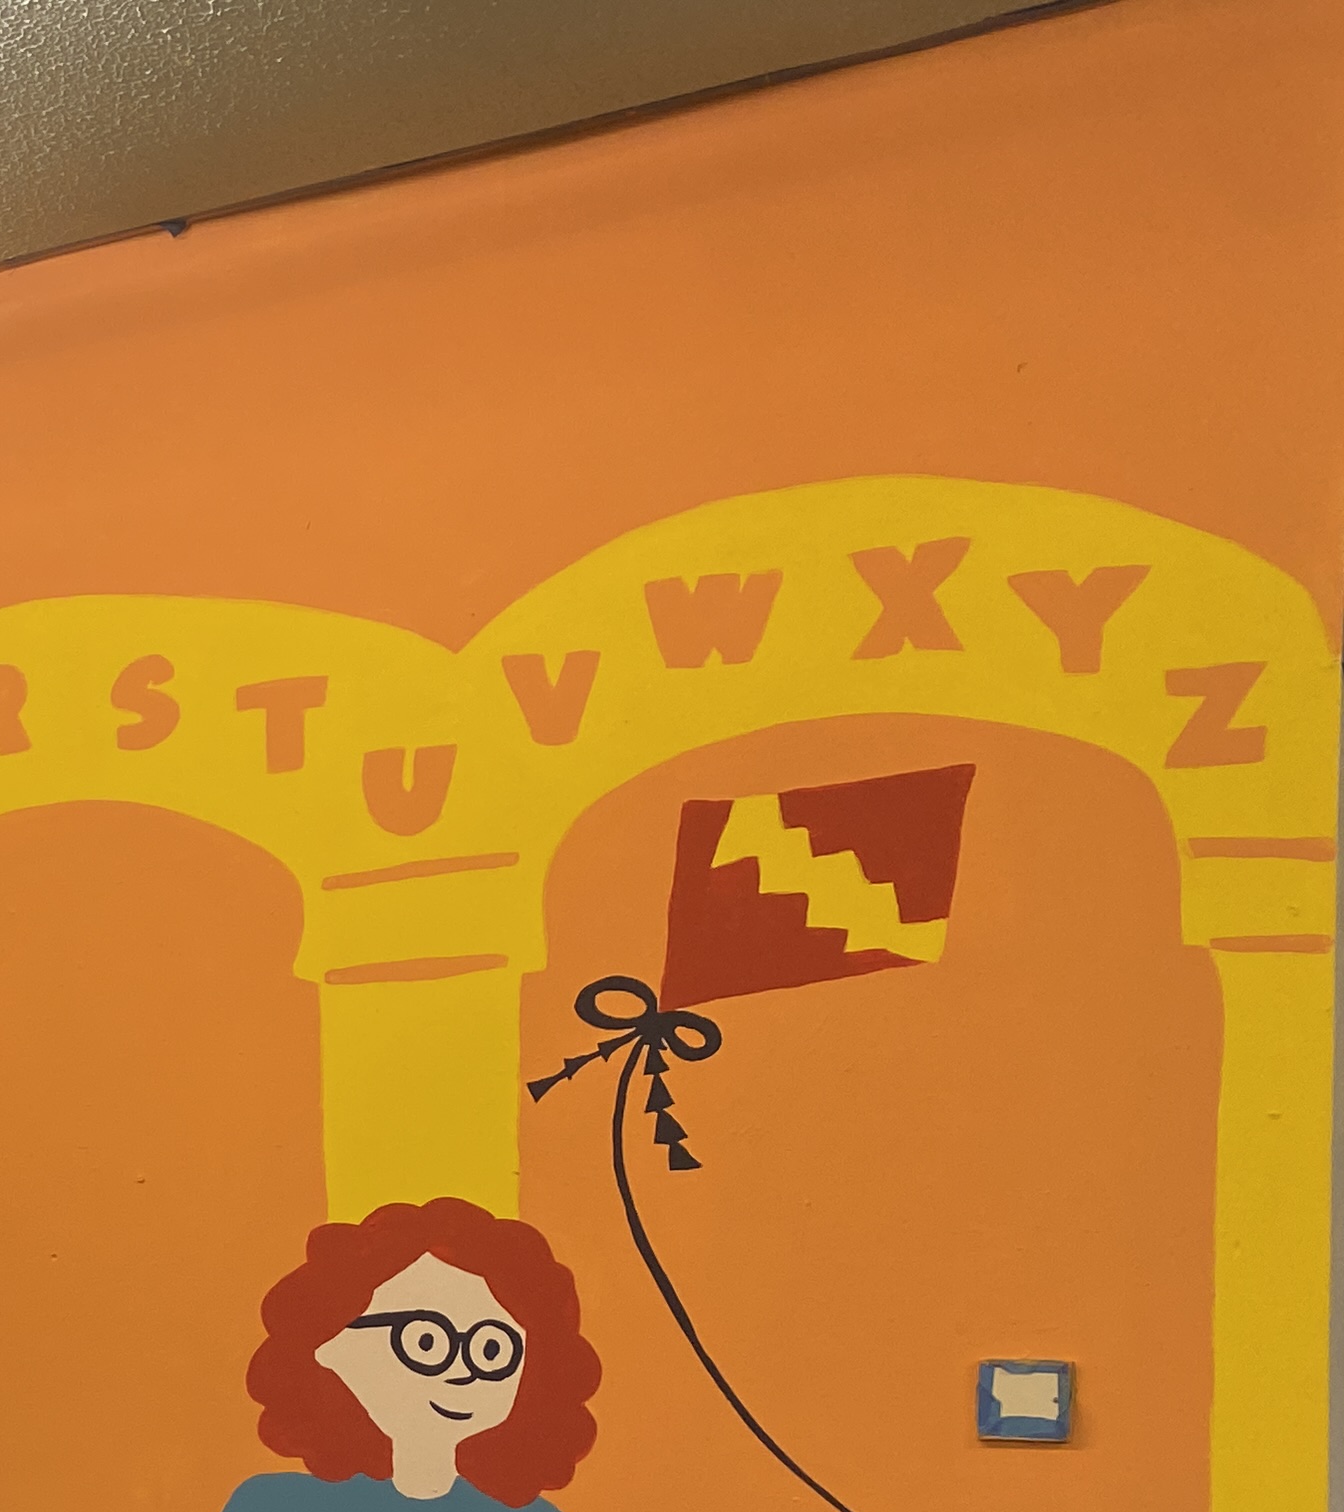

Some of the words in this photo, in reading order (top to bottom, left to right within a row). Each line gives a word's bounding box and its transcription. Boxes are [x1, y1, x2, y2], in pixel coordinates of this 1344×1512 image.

[110, 654, 180, 751] S
[236, 675, 329, 774] T
[361, 744, 457, 836] U
[501, 650, 601, 746] V
[644, 569, 783, 669] W
[847, 537, 971, 660] X
[1007, 564, 1153, 674] Y
[1165, 661, 1268, 769] Z
